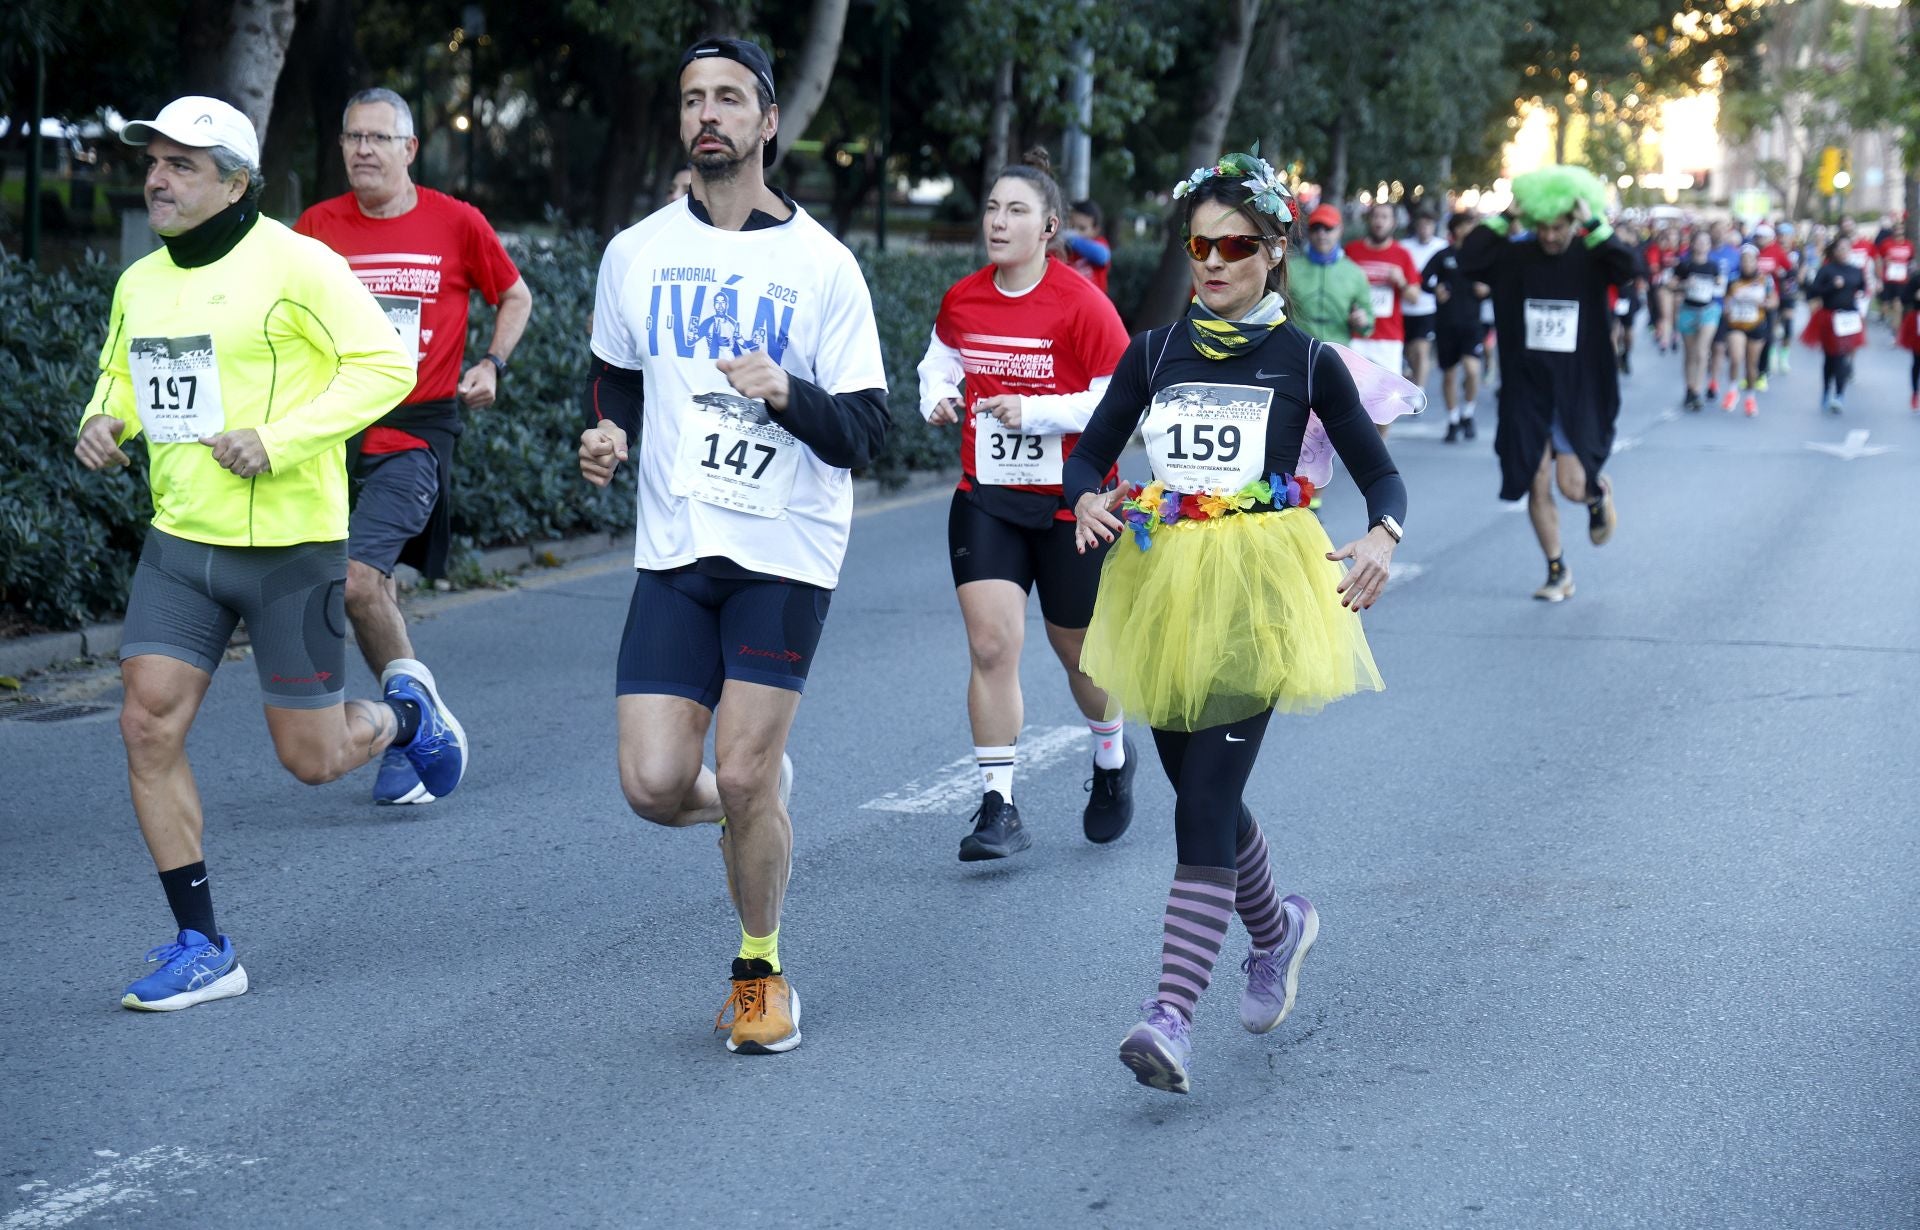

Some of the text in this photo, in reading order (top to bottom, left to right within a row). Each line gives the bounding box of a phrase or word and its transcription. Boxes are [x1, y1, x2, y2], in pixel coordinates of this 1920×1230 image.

[394, 268, 441, 280] CARRERA
[652, 267, 717, 283] I MEMORIAL
[391, 283, 440, 294] PALMILLA
[766, 282, 799, 304] 2025
[649, 274, 795, 367] IVÁN
[994, 360, 1054, 371] SAN SILVESTRE
[1008, 352, 1054, 364] CARRERA
[976, 365, 1055, 379] PALMA PALMILLA
[149, 375, 198, 410] 197
[1229, 400, 1267, 408] XIV
[990, 432, 1044, 461] 373
[1166, 423, 1242, 463] 159
[700, 433, 777, 480] 147
